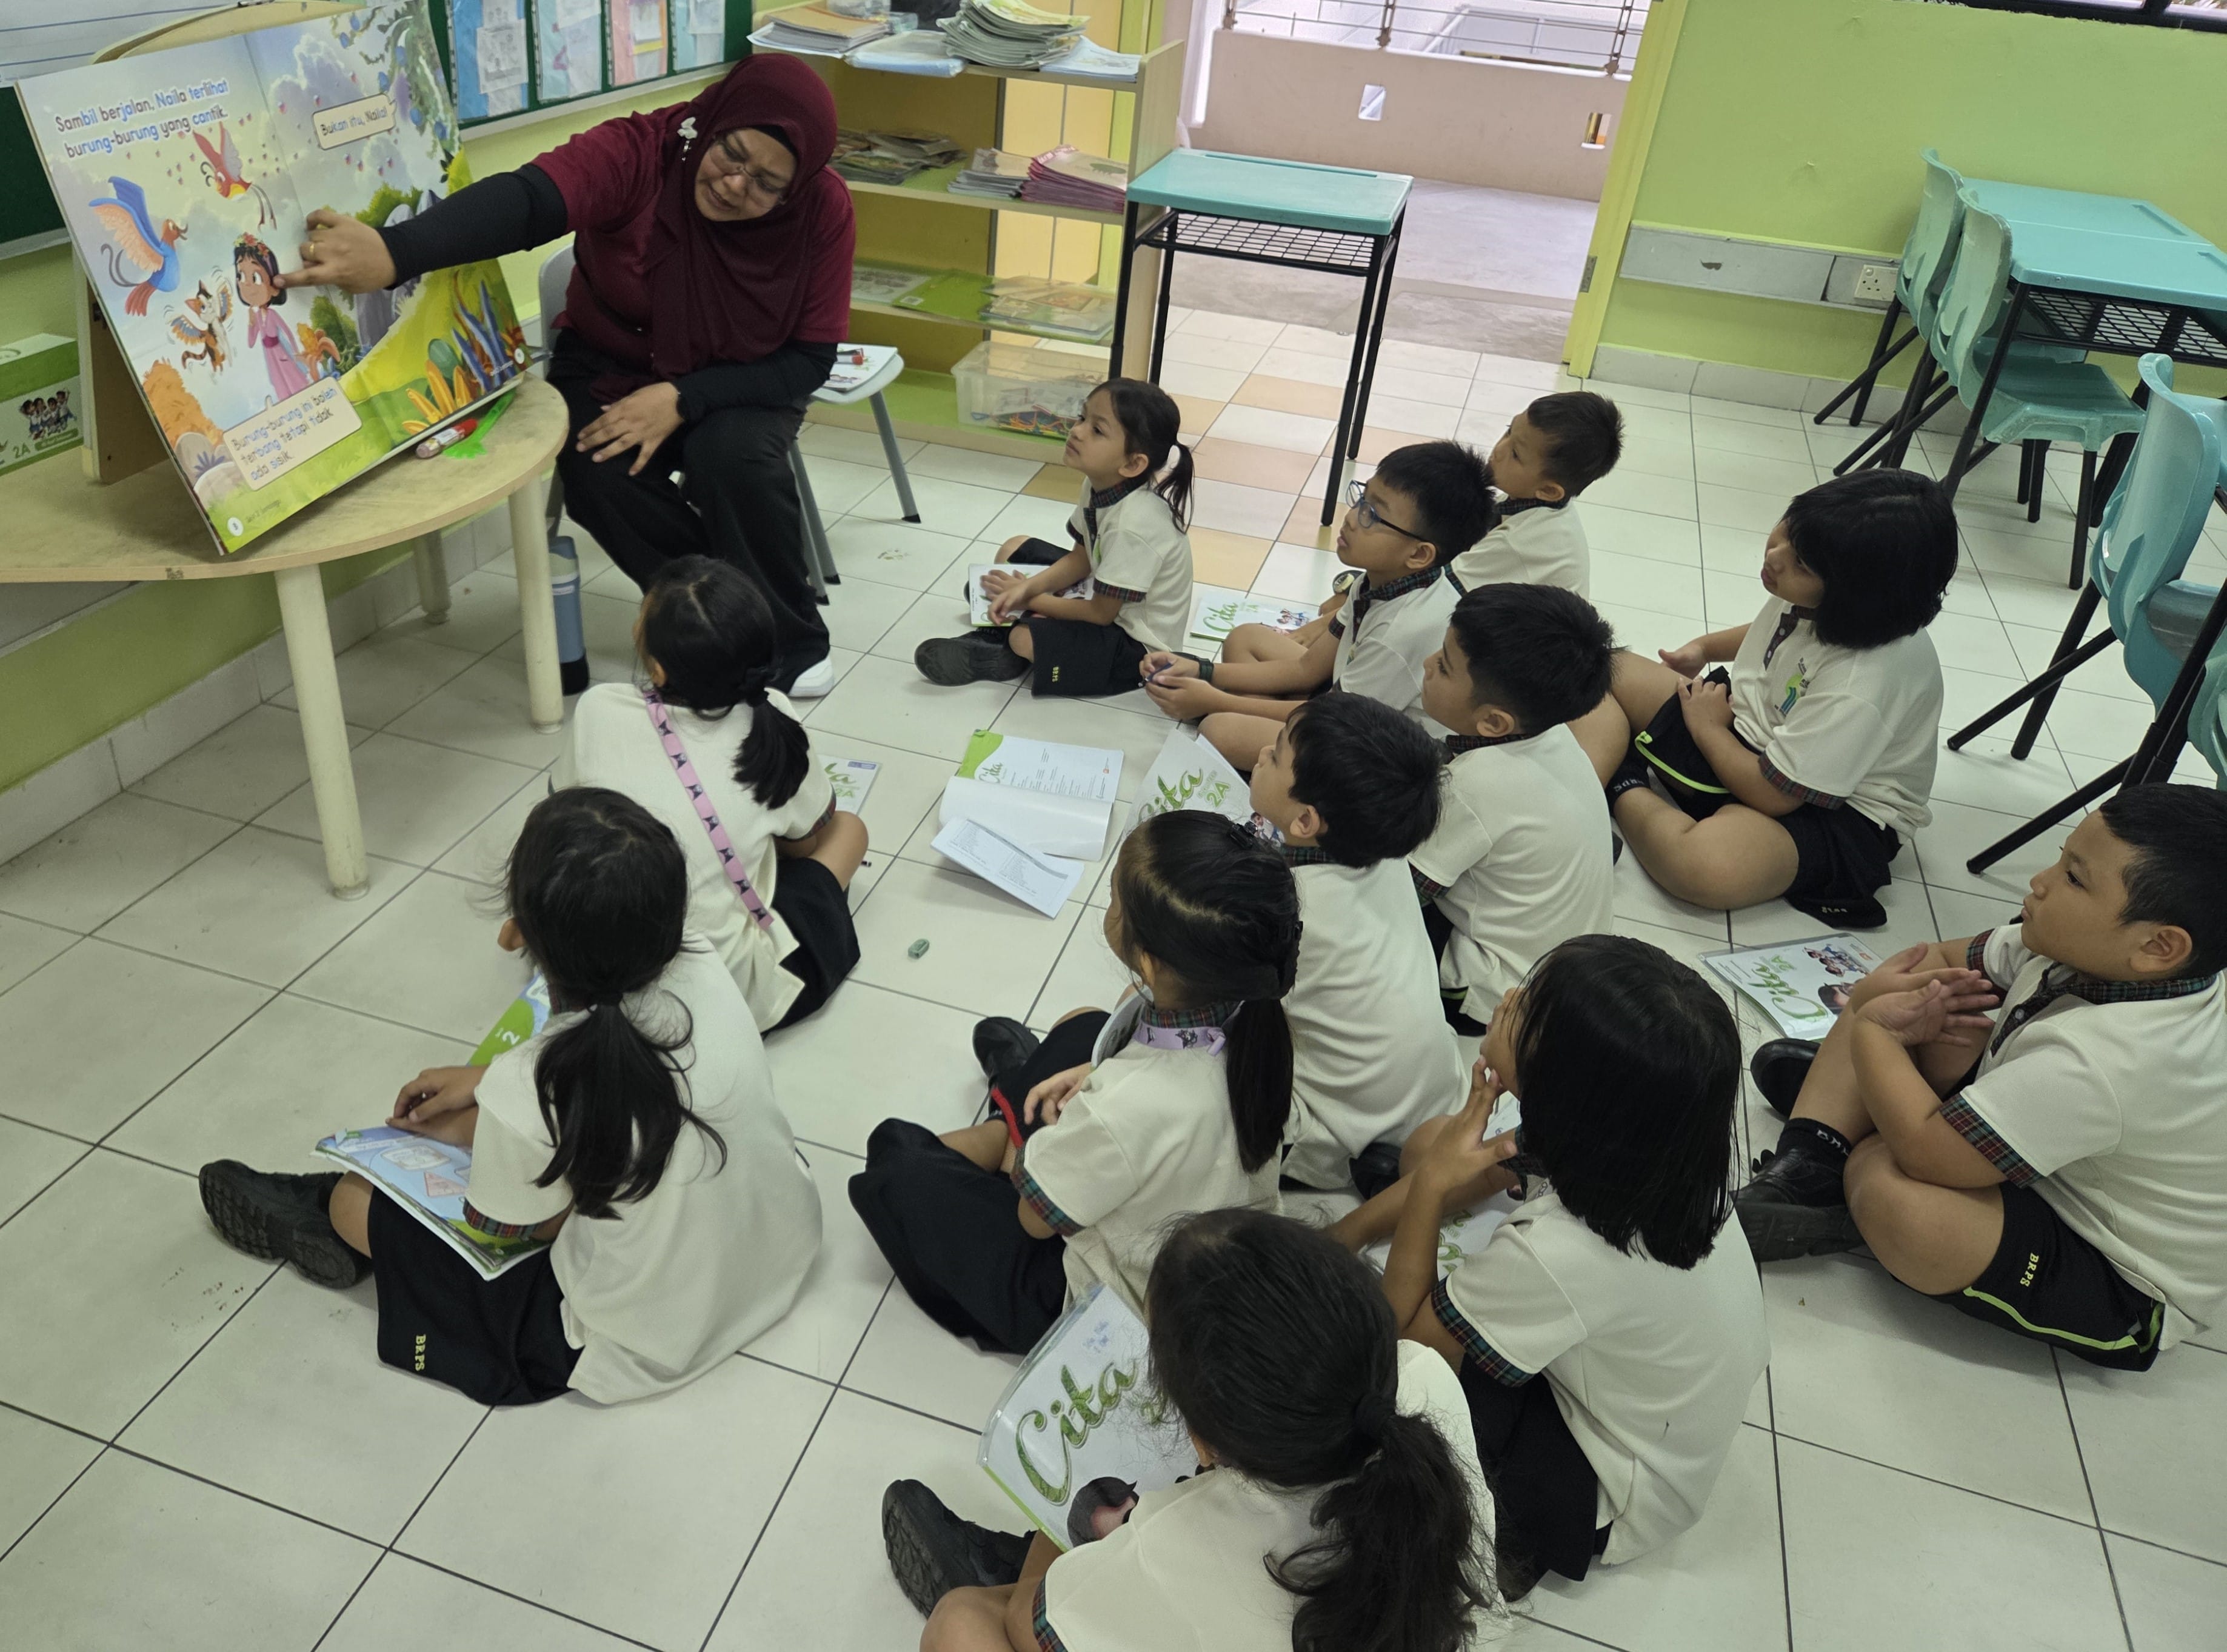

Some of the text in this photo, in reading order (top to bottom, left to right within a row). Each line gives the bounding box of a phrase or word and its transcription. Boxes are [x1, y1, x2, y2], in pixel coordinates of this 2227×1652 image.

[56, 80, 229, 132] Sambil berjalan, Naila terlihat
[65, 104, 229, 158] burung-burung yang cantik.
[232, 408, 303, 451] Burung-burung
[312, 387, 337, 406] boleh
[241, 407, 333, 465] terbang tetapi tidak
[12, 443, 31, 459] 2A
[251, 465, 269, 481] ada
[1203, 602, 1238, 633] Cita
[1206, 781, 1230, 807] 2A
[1748, 961, 1828, 1021] Cita
[502, 1030, 521, 1045] 2
[2020, 1252, 2040, 1287] BRPS
[415, 1334, 426, 1371] BRPS
[1015, 1361, 1138, 1506] Cita
